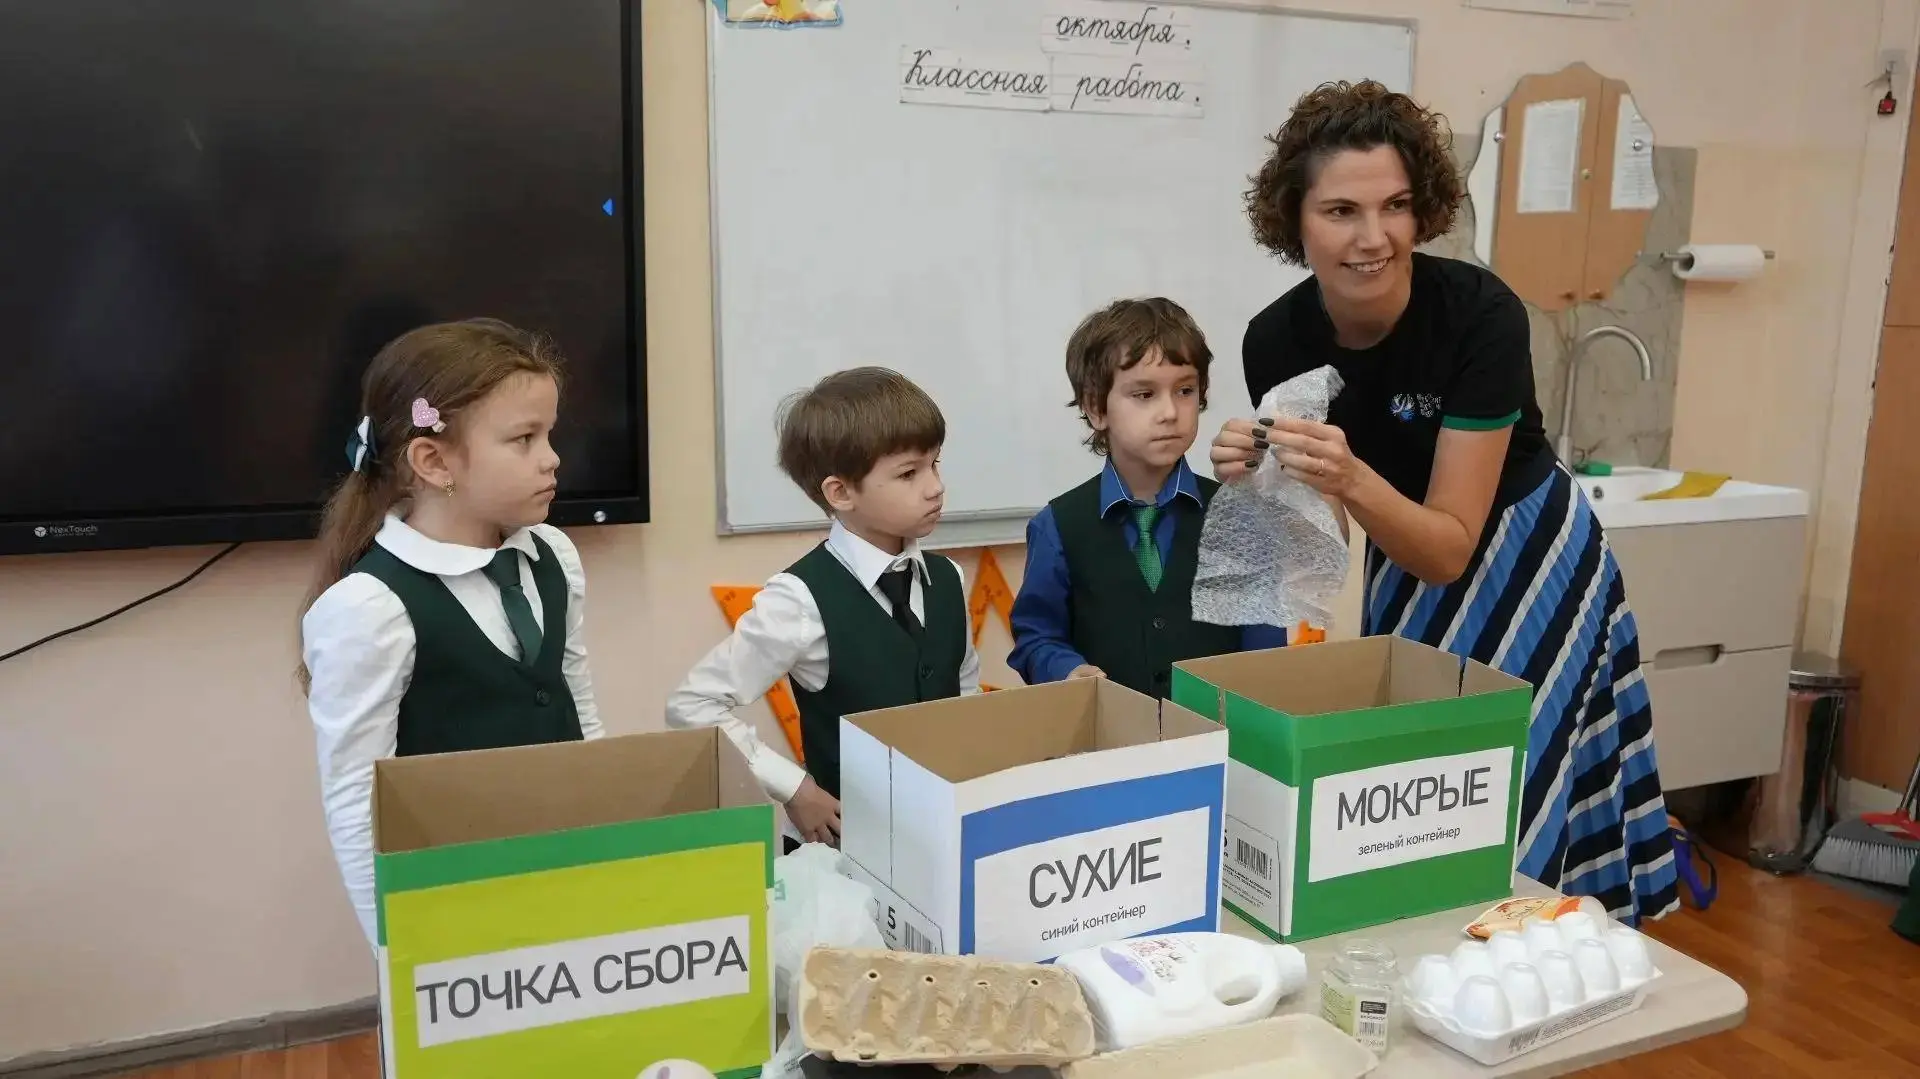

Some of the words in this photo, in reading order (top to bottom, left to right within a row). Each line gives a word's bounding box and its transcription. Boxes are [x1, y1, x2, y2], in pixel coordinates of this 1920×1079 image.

[1337, 766, 1491, 830] МОКРЫЕ
[1358, 834, 1404, 856] зеленый
[1406, 826, 1461, 846] контейнер
[1029, 837, 1162, 908] СУХИЕ
[887, 905, 896, 930] 5
[1041, 918, 1079, 941] синий
[1082, 904, 1146, 930] контейнер
[416, 961, 582, 1024] ТОЧКА
[593, 936, 748, 994] СБОРА
